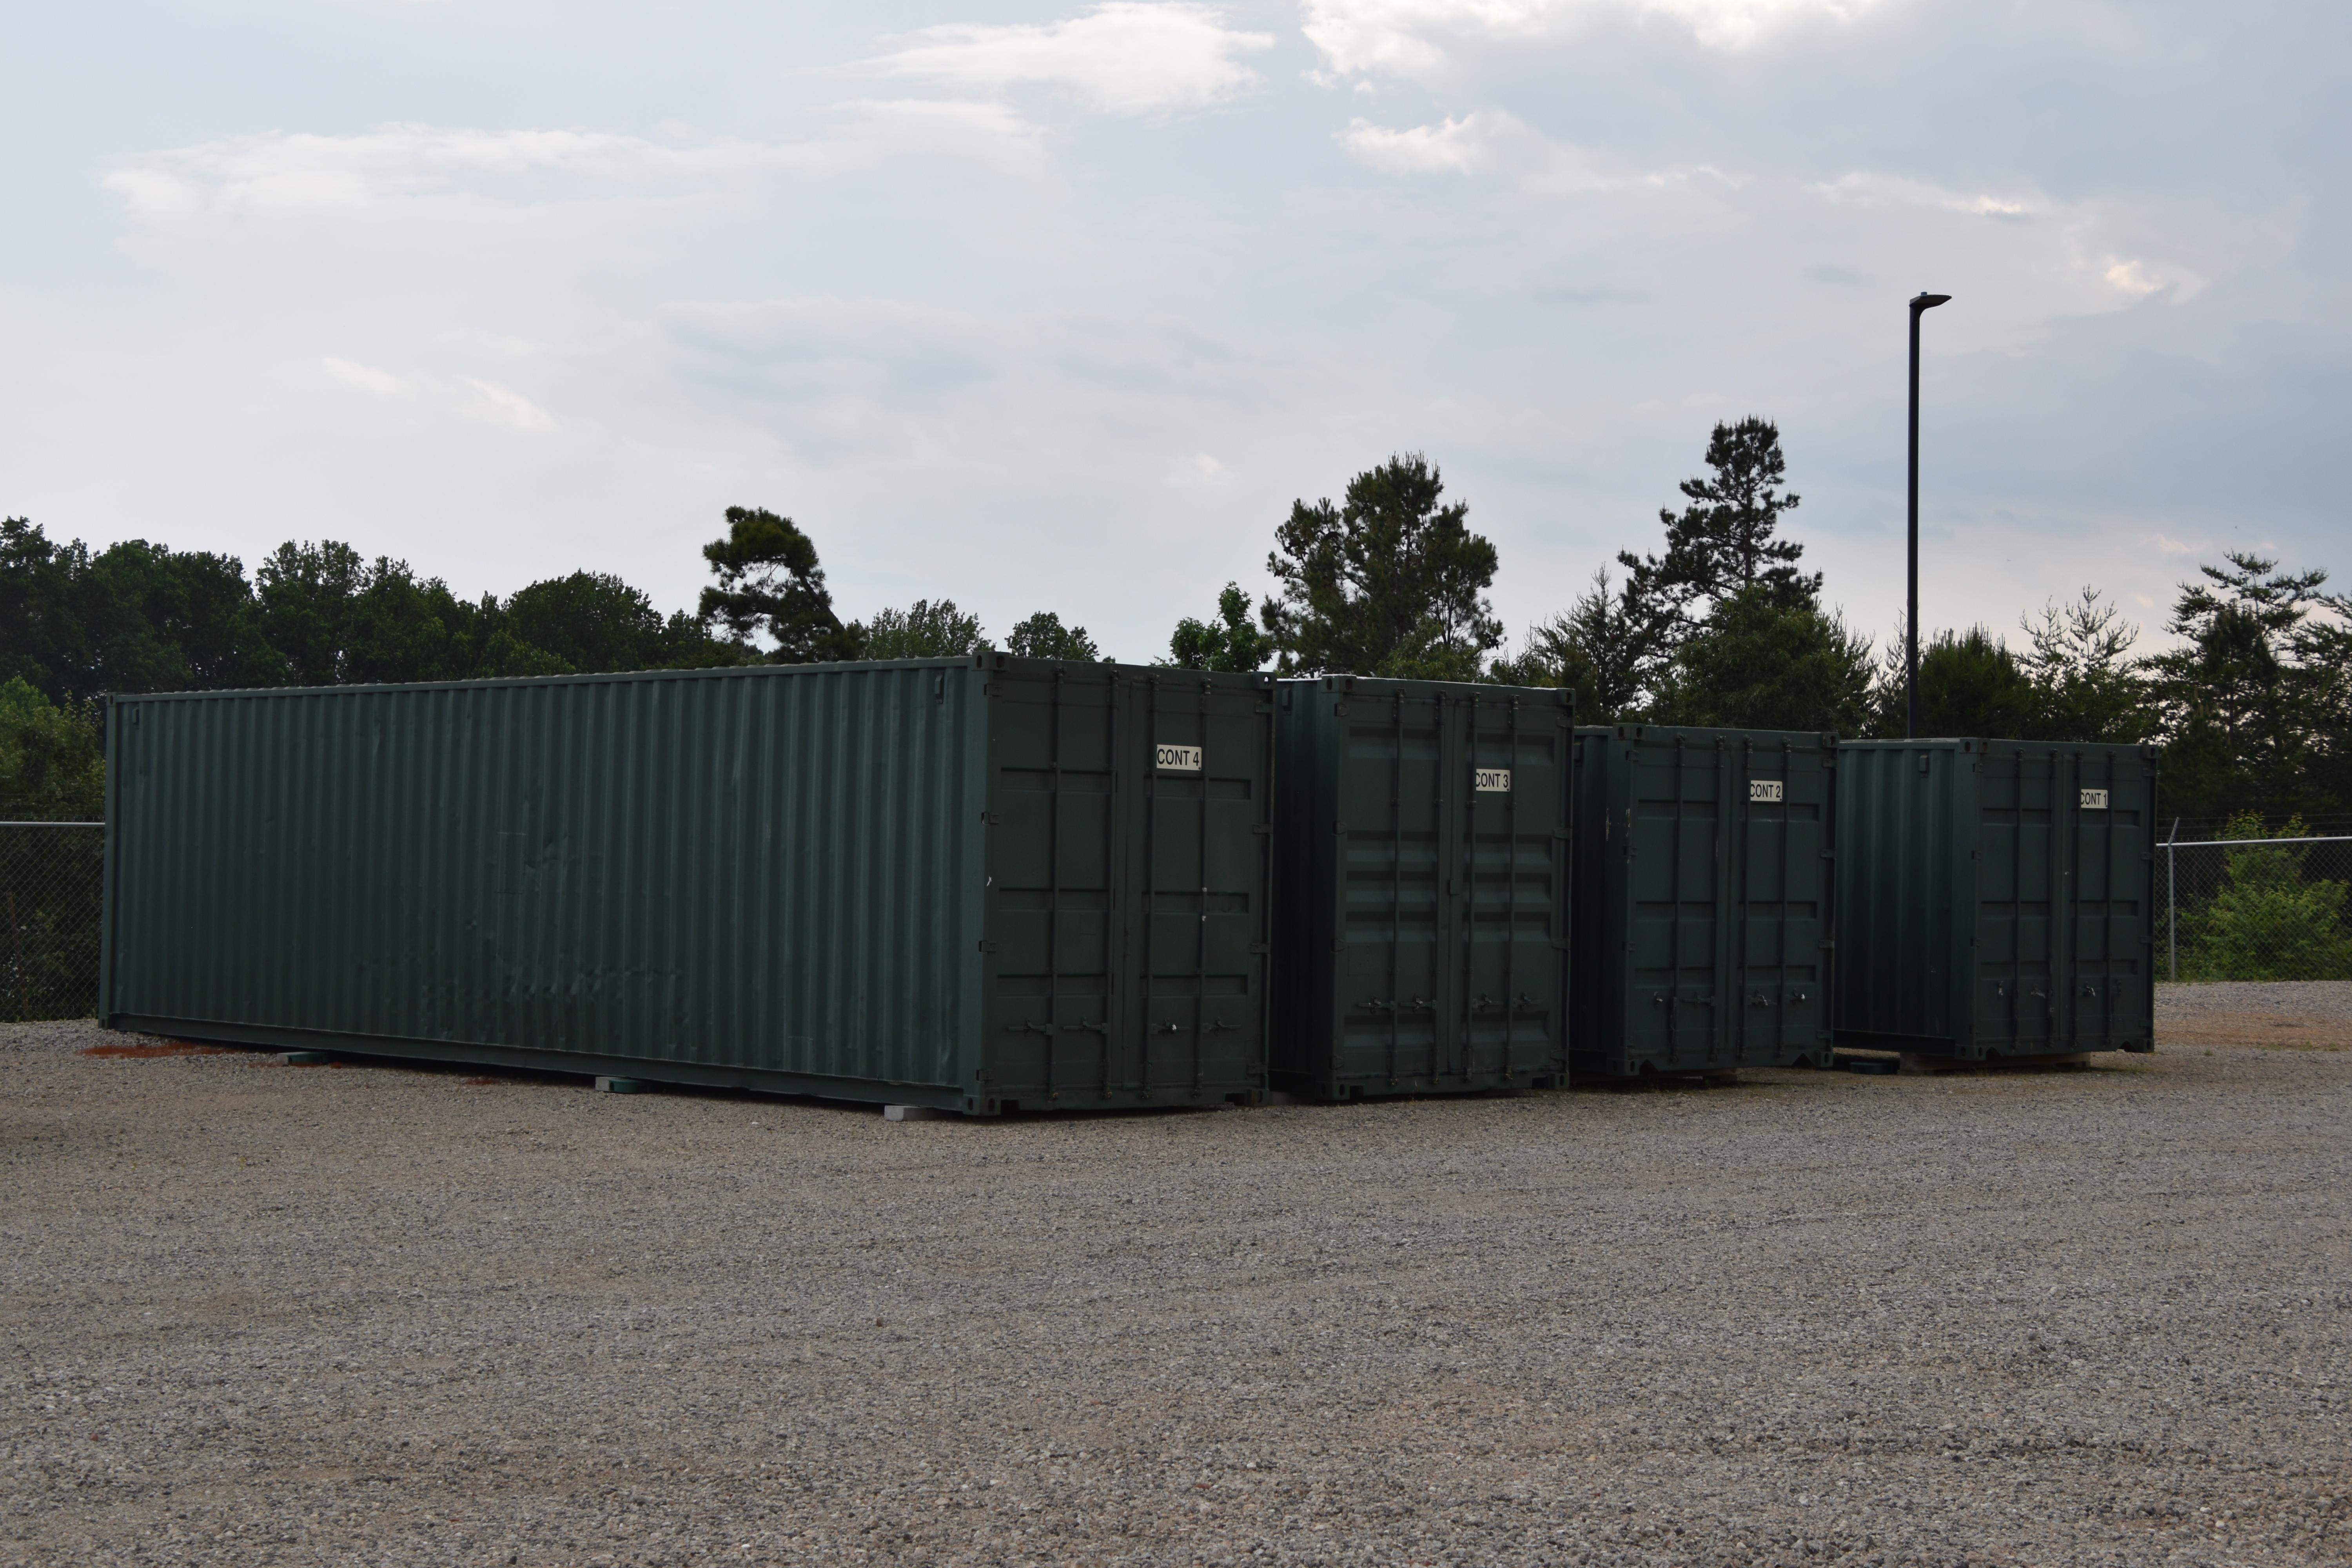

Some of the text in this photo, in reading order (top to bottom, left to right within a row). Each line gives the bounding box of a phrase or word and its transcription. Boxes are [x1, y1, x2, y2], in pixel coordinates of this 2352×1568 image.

[1157, 748, 1199, 766] CONT 4
[1503, 774, 1508, 788] 3
[1750, 784, 1780, 798] CONT 2
[2103, 793, 2107, 805] 1
